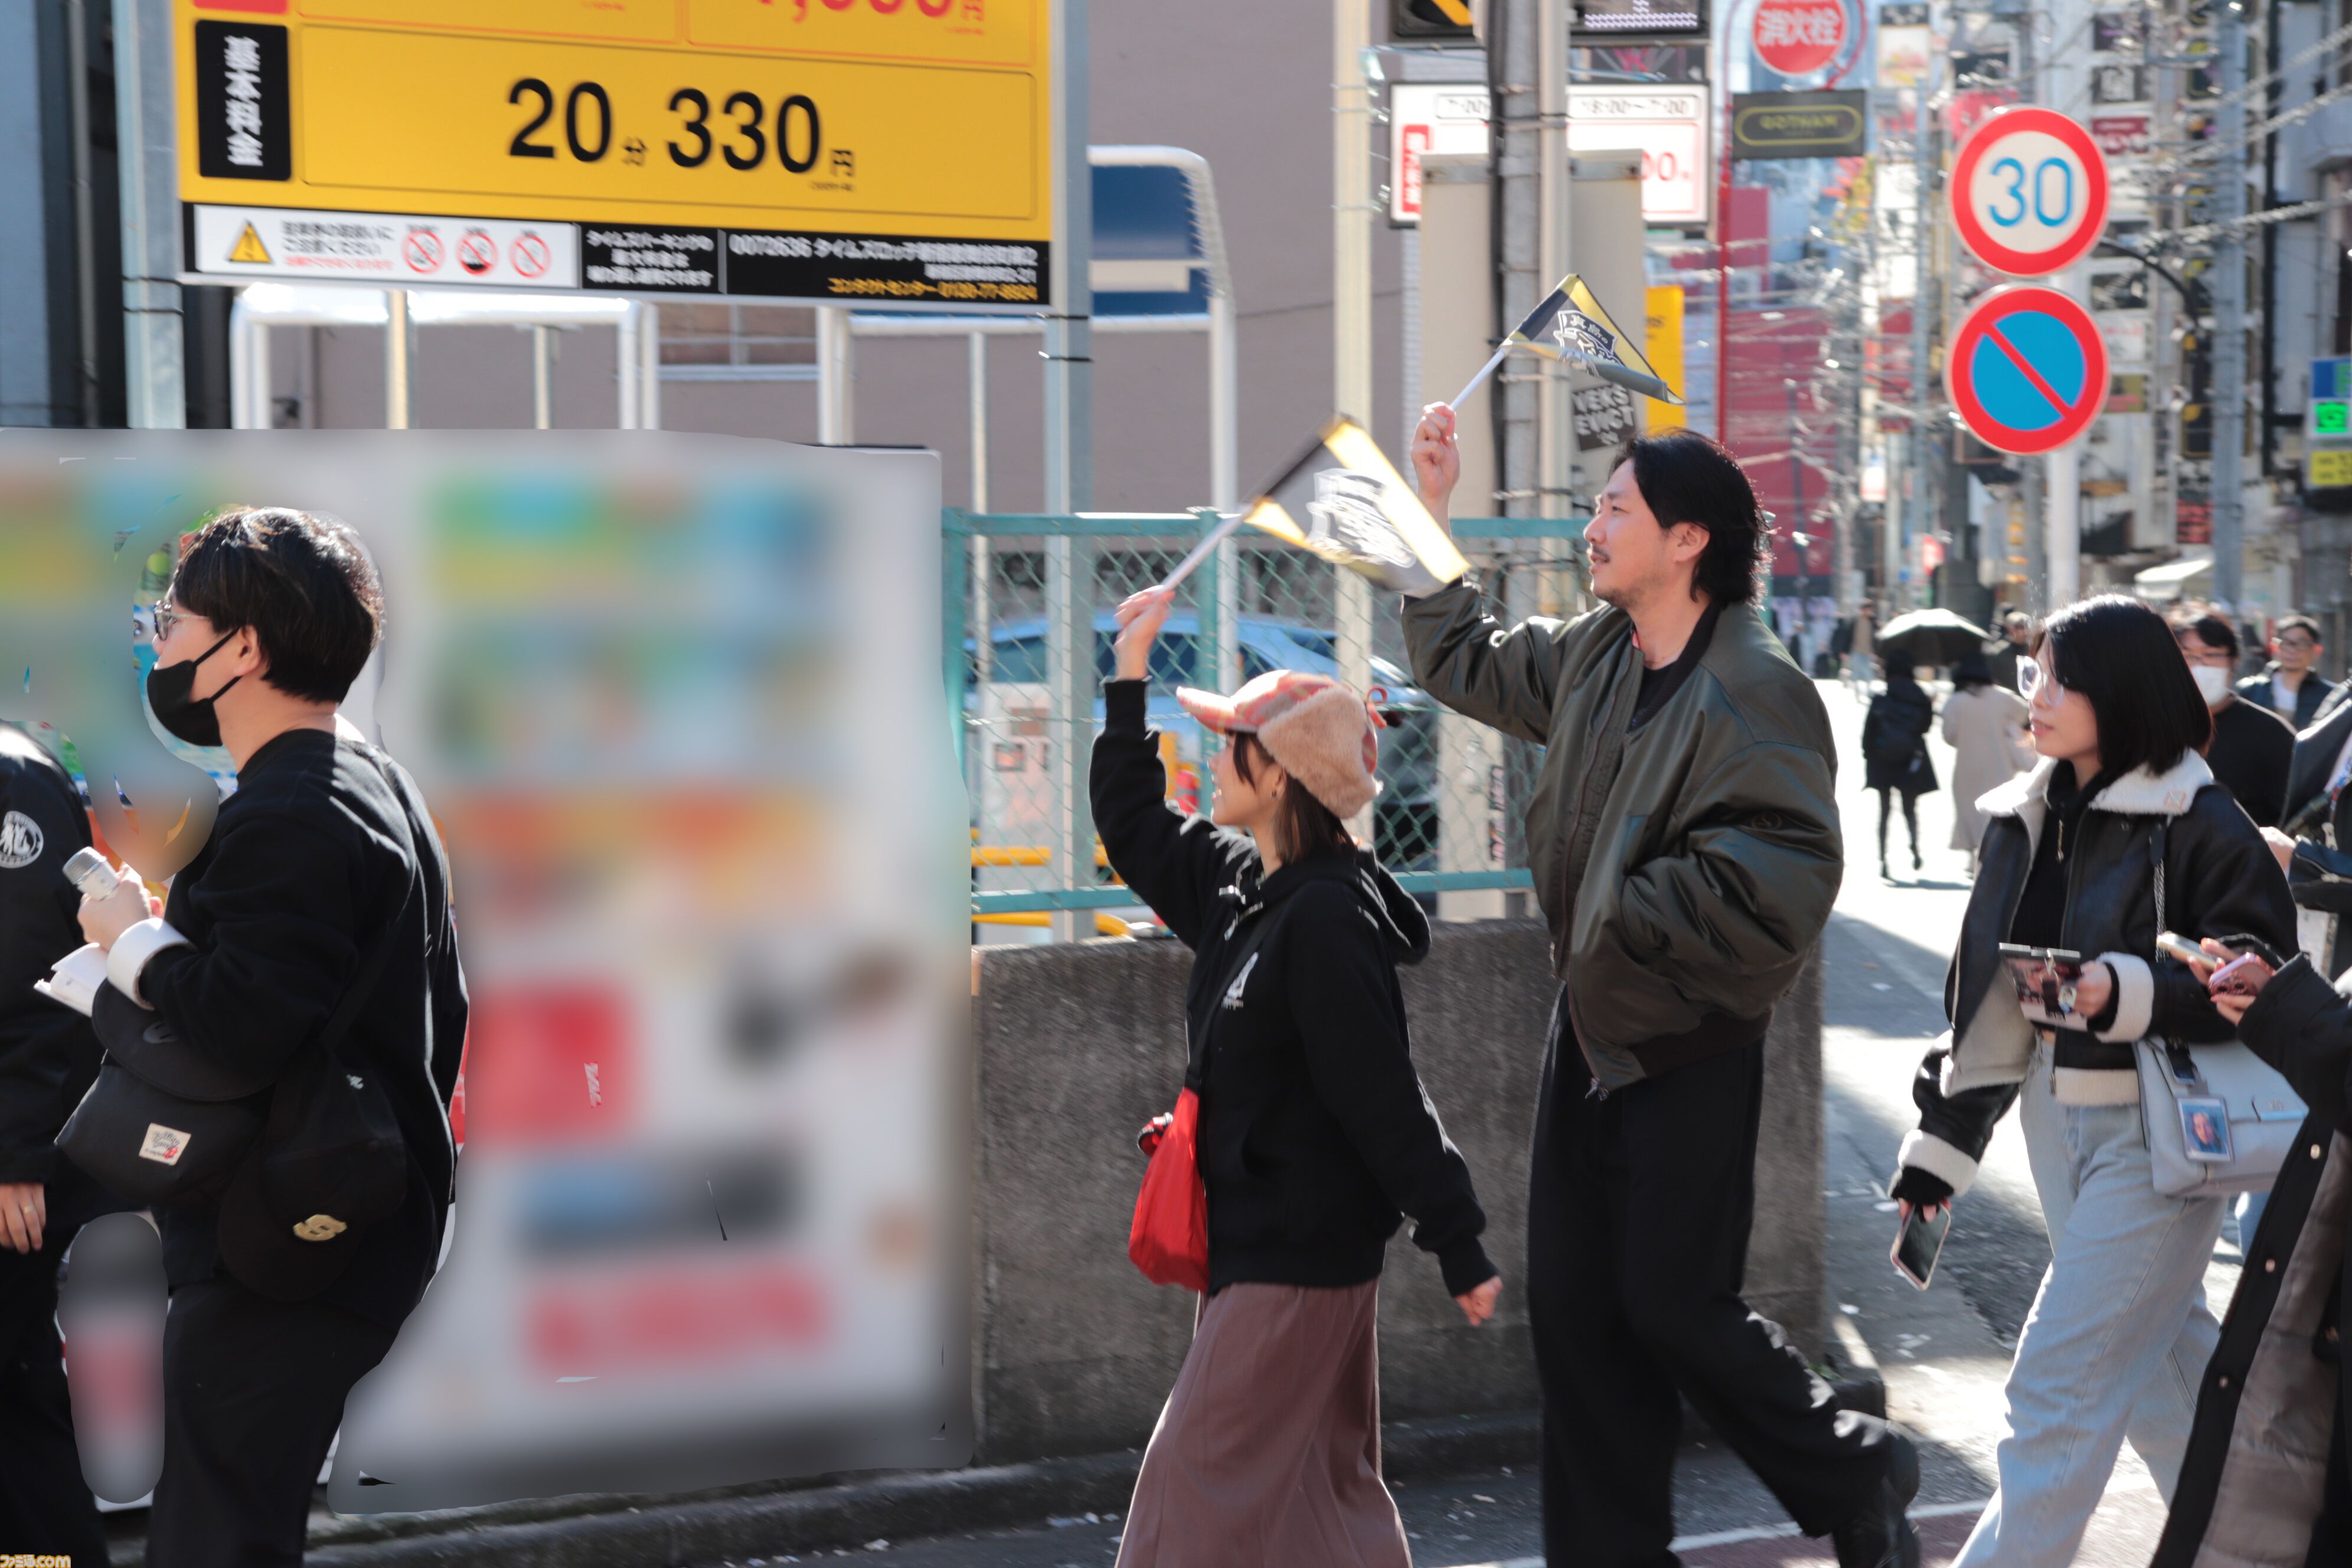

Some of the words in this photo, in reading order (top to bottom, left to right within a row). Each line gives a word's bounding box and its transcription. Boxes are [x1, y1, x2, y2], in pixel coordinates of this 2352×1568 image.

[1758, 7, 1840, 46] 消火栓
[1989, 157, 2073, 227] 30
